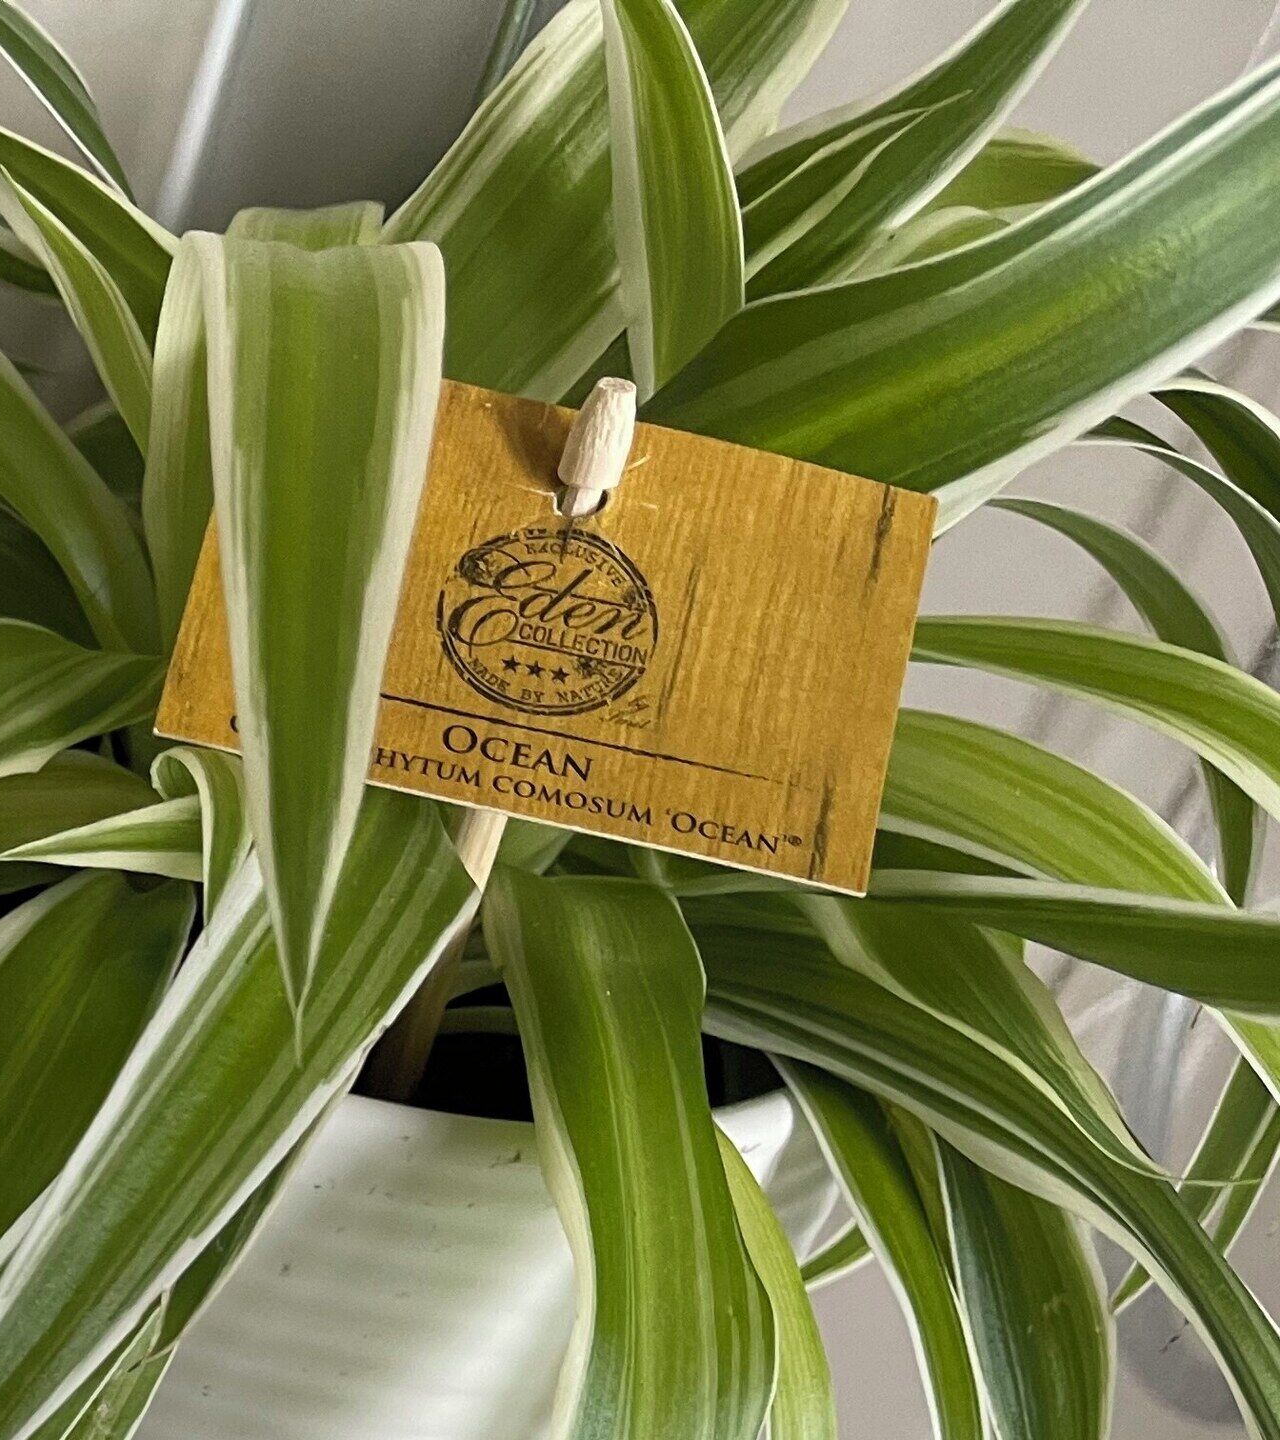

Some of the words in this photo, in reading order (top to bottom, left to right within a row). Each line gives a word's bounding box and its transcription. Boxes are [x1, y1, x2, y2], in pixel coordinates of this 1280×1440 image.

[448, 550, 647, 658] Eden
[519, 622, 648, 665] COLLECTION
[467, 660, 510, 692] MADE
[521, 688, 544, 703] BY
[442, 724, 593, 782] OCEAN
[492, 775, 652, 827] COMOSUM
